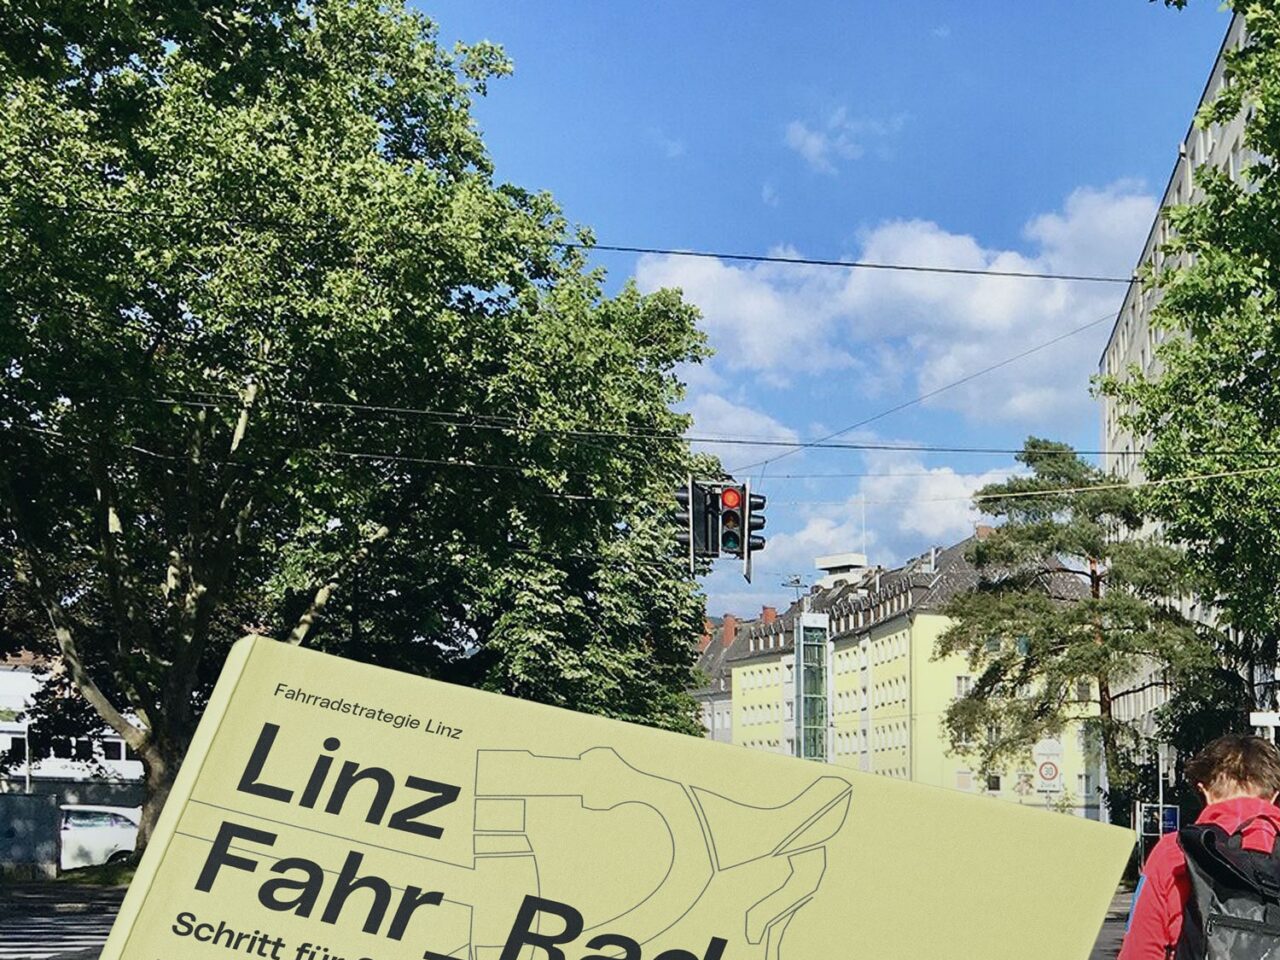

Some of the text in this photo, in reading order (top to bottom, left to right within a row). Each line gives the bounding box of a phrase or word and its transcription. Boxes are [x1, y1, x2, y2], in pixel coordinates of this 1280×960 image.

[273, 682, 464, 740] Fahrradstrategie Linz
[237, 722, 461, 840] Linz
[172, 912, 286, 960] Schritt
